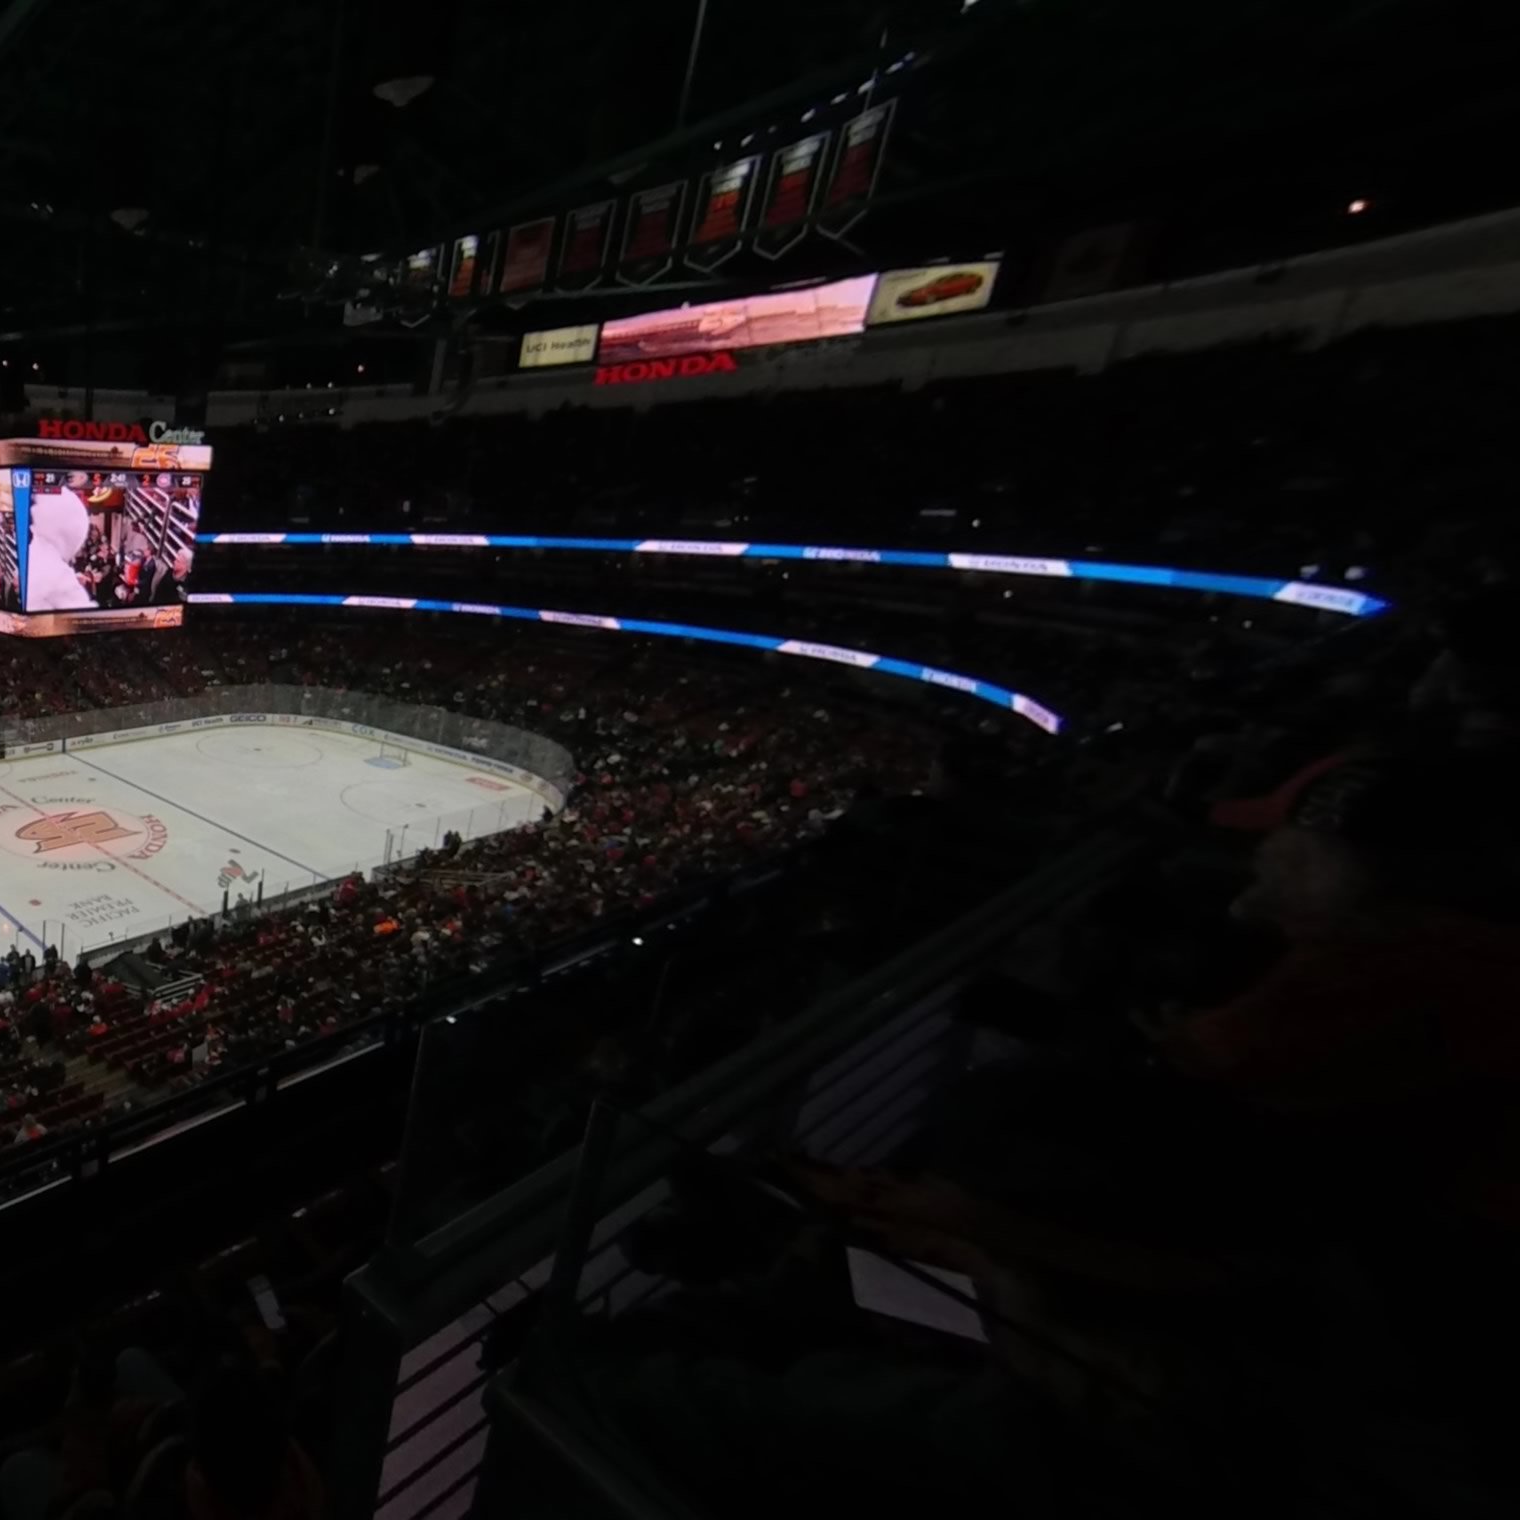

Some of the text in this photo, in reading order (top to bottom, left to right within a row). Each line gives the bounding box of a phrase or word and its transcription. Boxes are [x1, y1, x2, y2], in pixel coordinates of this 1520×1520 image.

[594, 350, 737, 385] HONDA
[38, 419, 205, 444] HONDA Center
[229, 715, 267, 723] GEICO
[352, 724, 375, 737] COX
[31, 795, 96, 805] Center
[128, 813, 168, 861] HONDA
[37, 860, 116, 872] Center
[66, 897, 134, 921] PREMIER
[68, 893, 114, 909] BANK
[81, 906, 141, 929] PACIFIC
